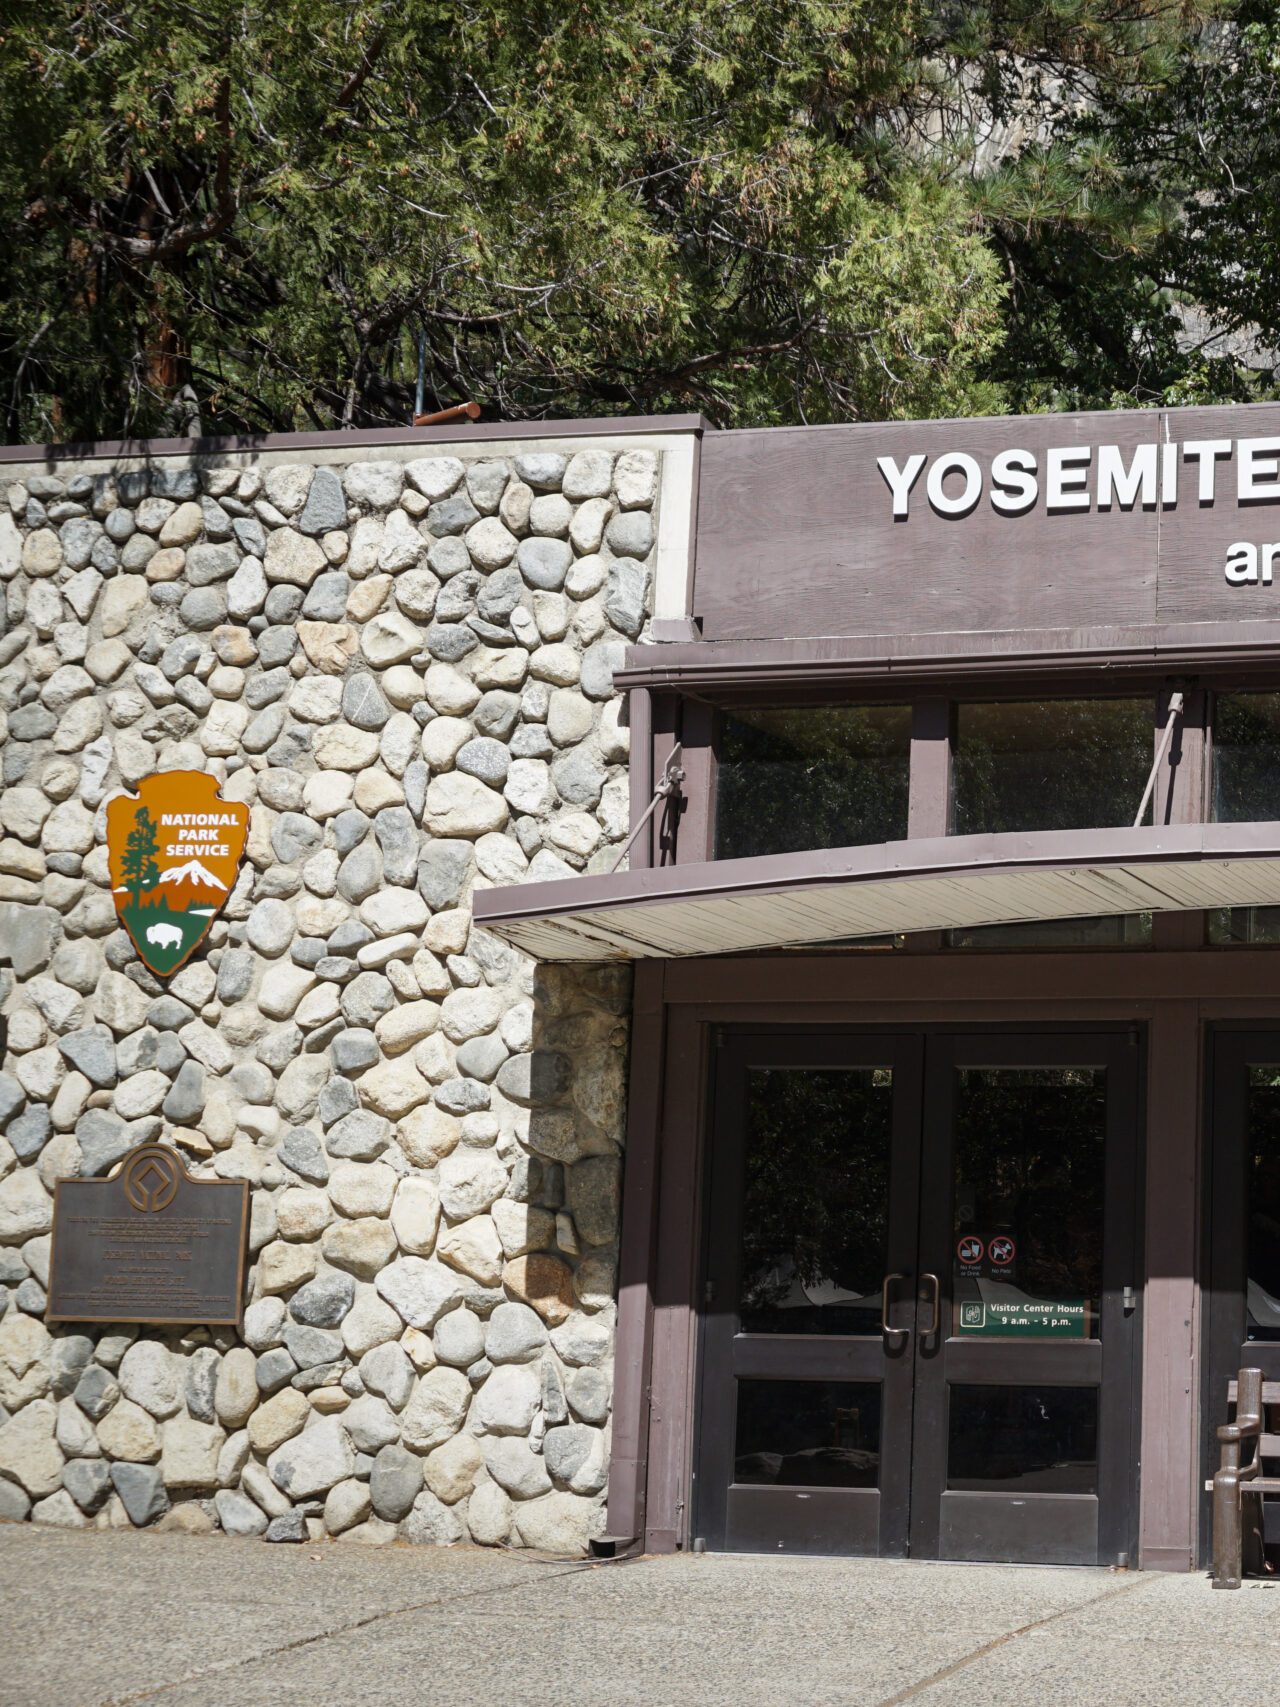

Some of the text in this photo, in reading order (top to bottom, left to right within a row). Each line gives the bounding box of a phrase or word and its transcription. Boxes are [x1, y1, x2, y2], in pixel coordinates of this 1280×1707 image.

[161, 814, 240, 826] NATIONAL
[178, 829, 219, 841] PARK
[166, 844, 230, 856] SERVICE
[990, 1304, 1084, 1313] Visitor Center Hours
[1001, 1317, 1008, 1325] 9
[1051, 1319, 1071, 1328] p.m.
